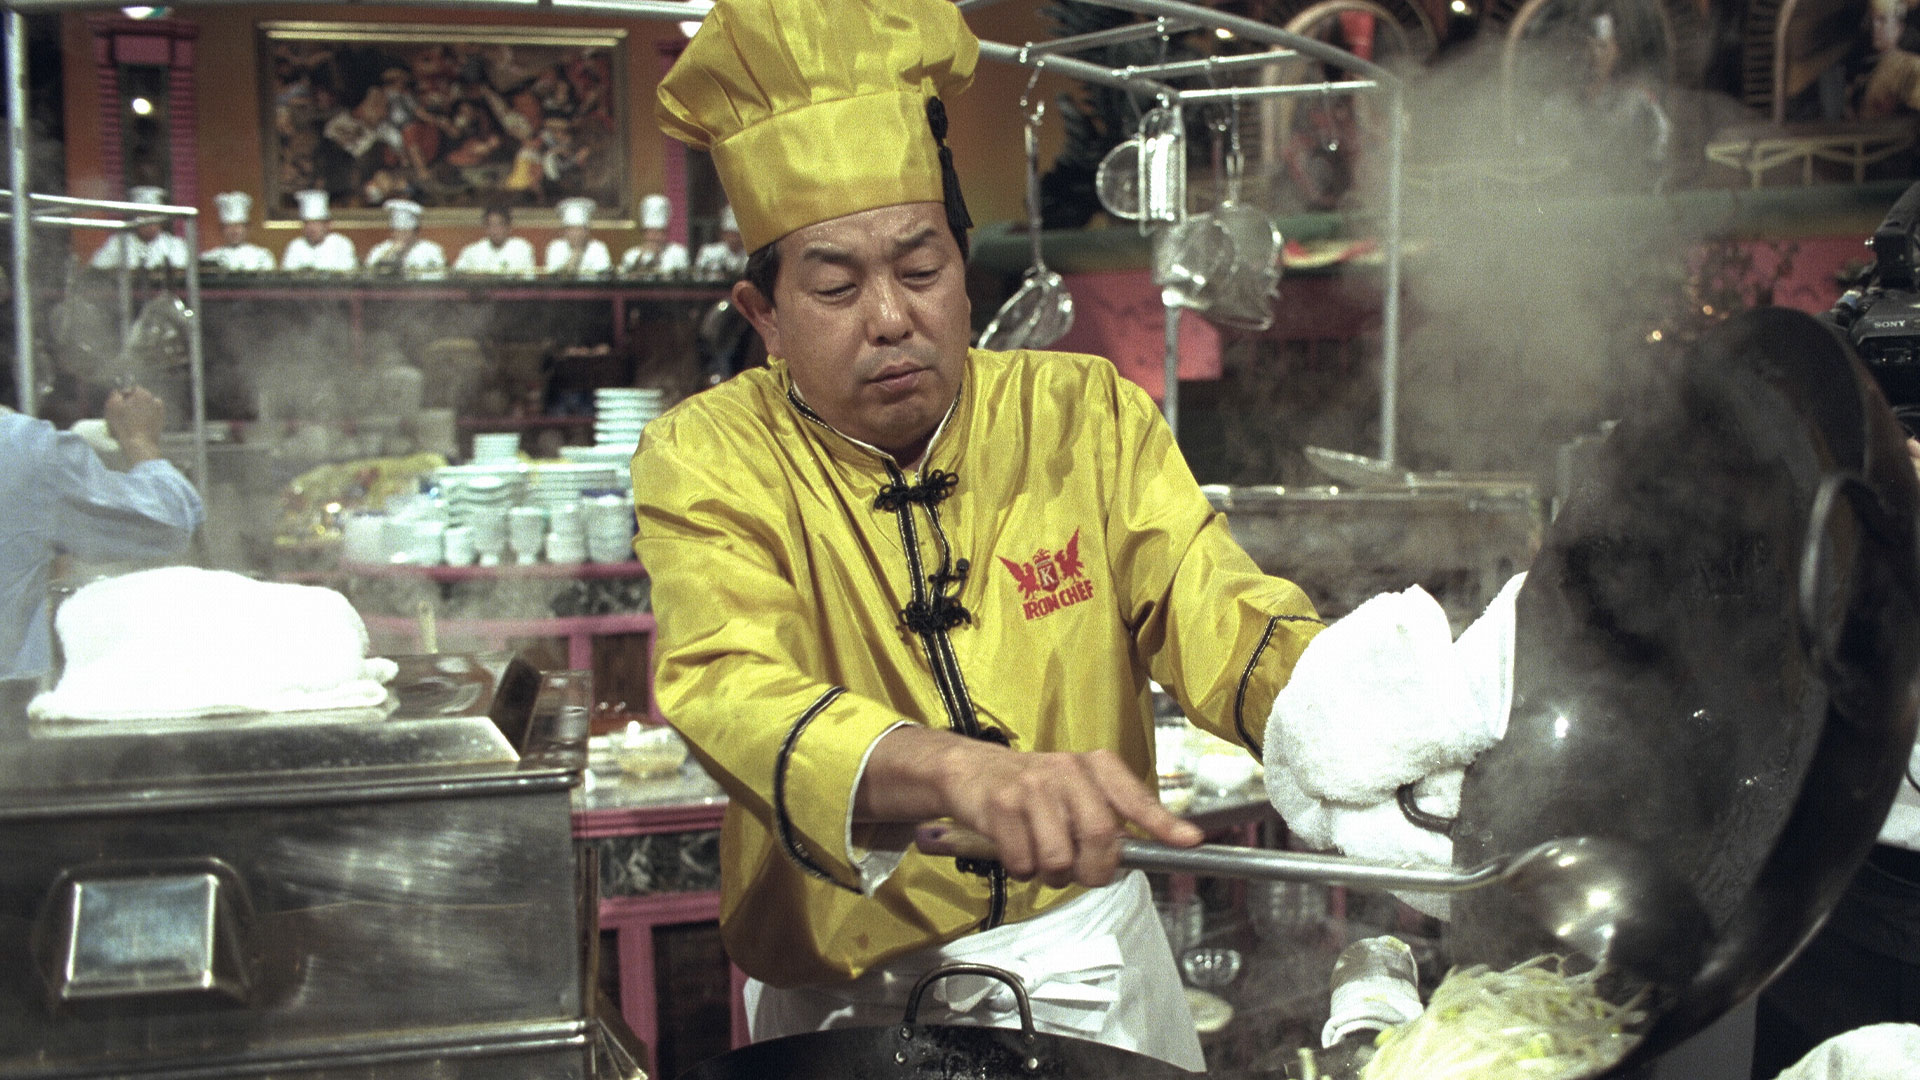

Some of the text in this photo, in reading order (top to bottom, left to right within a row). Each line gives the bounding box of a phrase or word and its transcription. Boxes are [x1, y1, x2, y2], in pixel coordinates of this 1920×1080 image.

[1874, 320, 1905, 328] SONY
[1039, 565, 1056, 587] K
[1022, 579, 1094, 620] IRON CHEF
